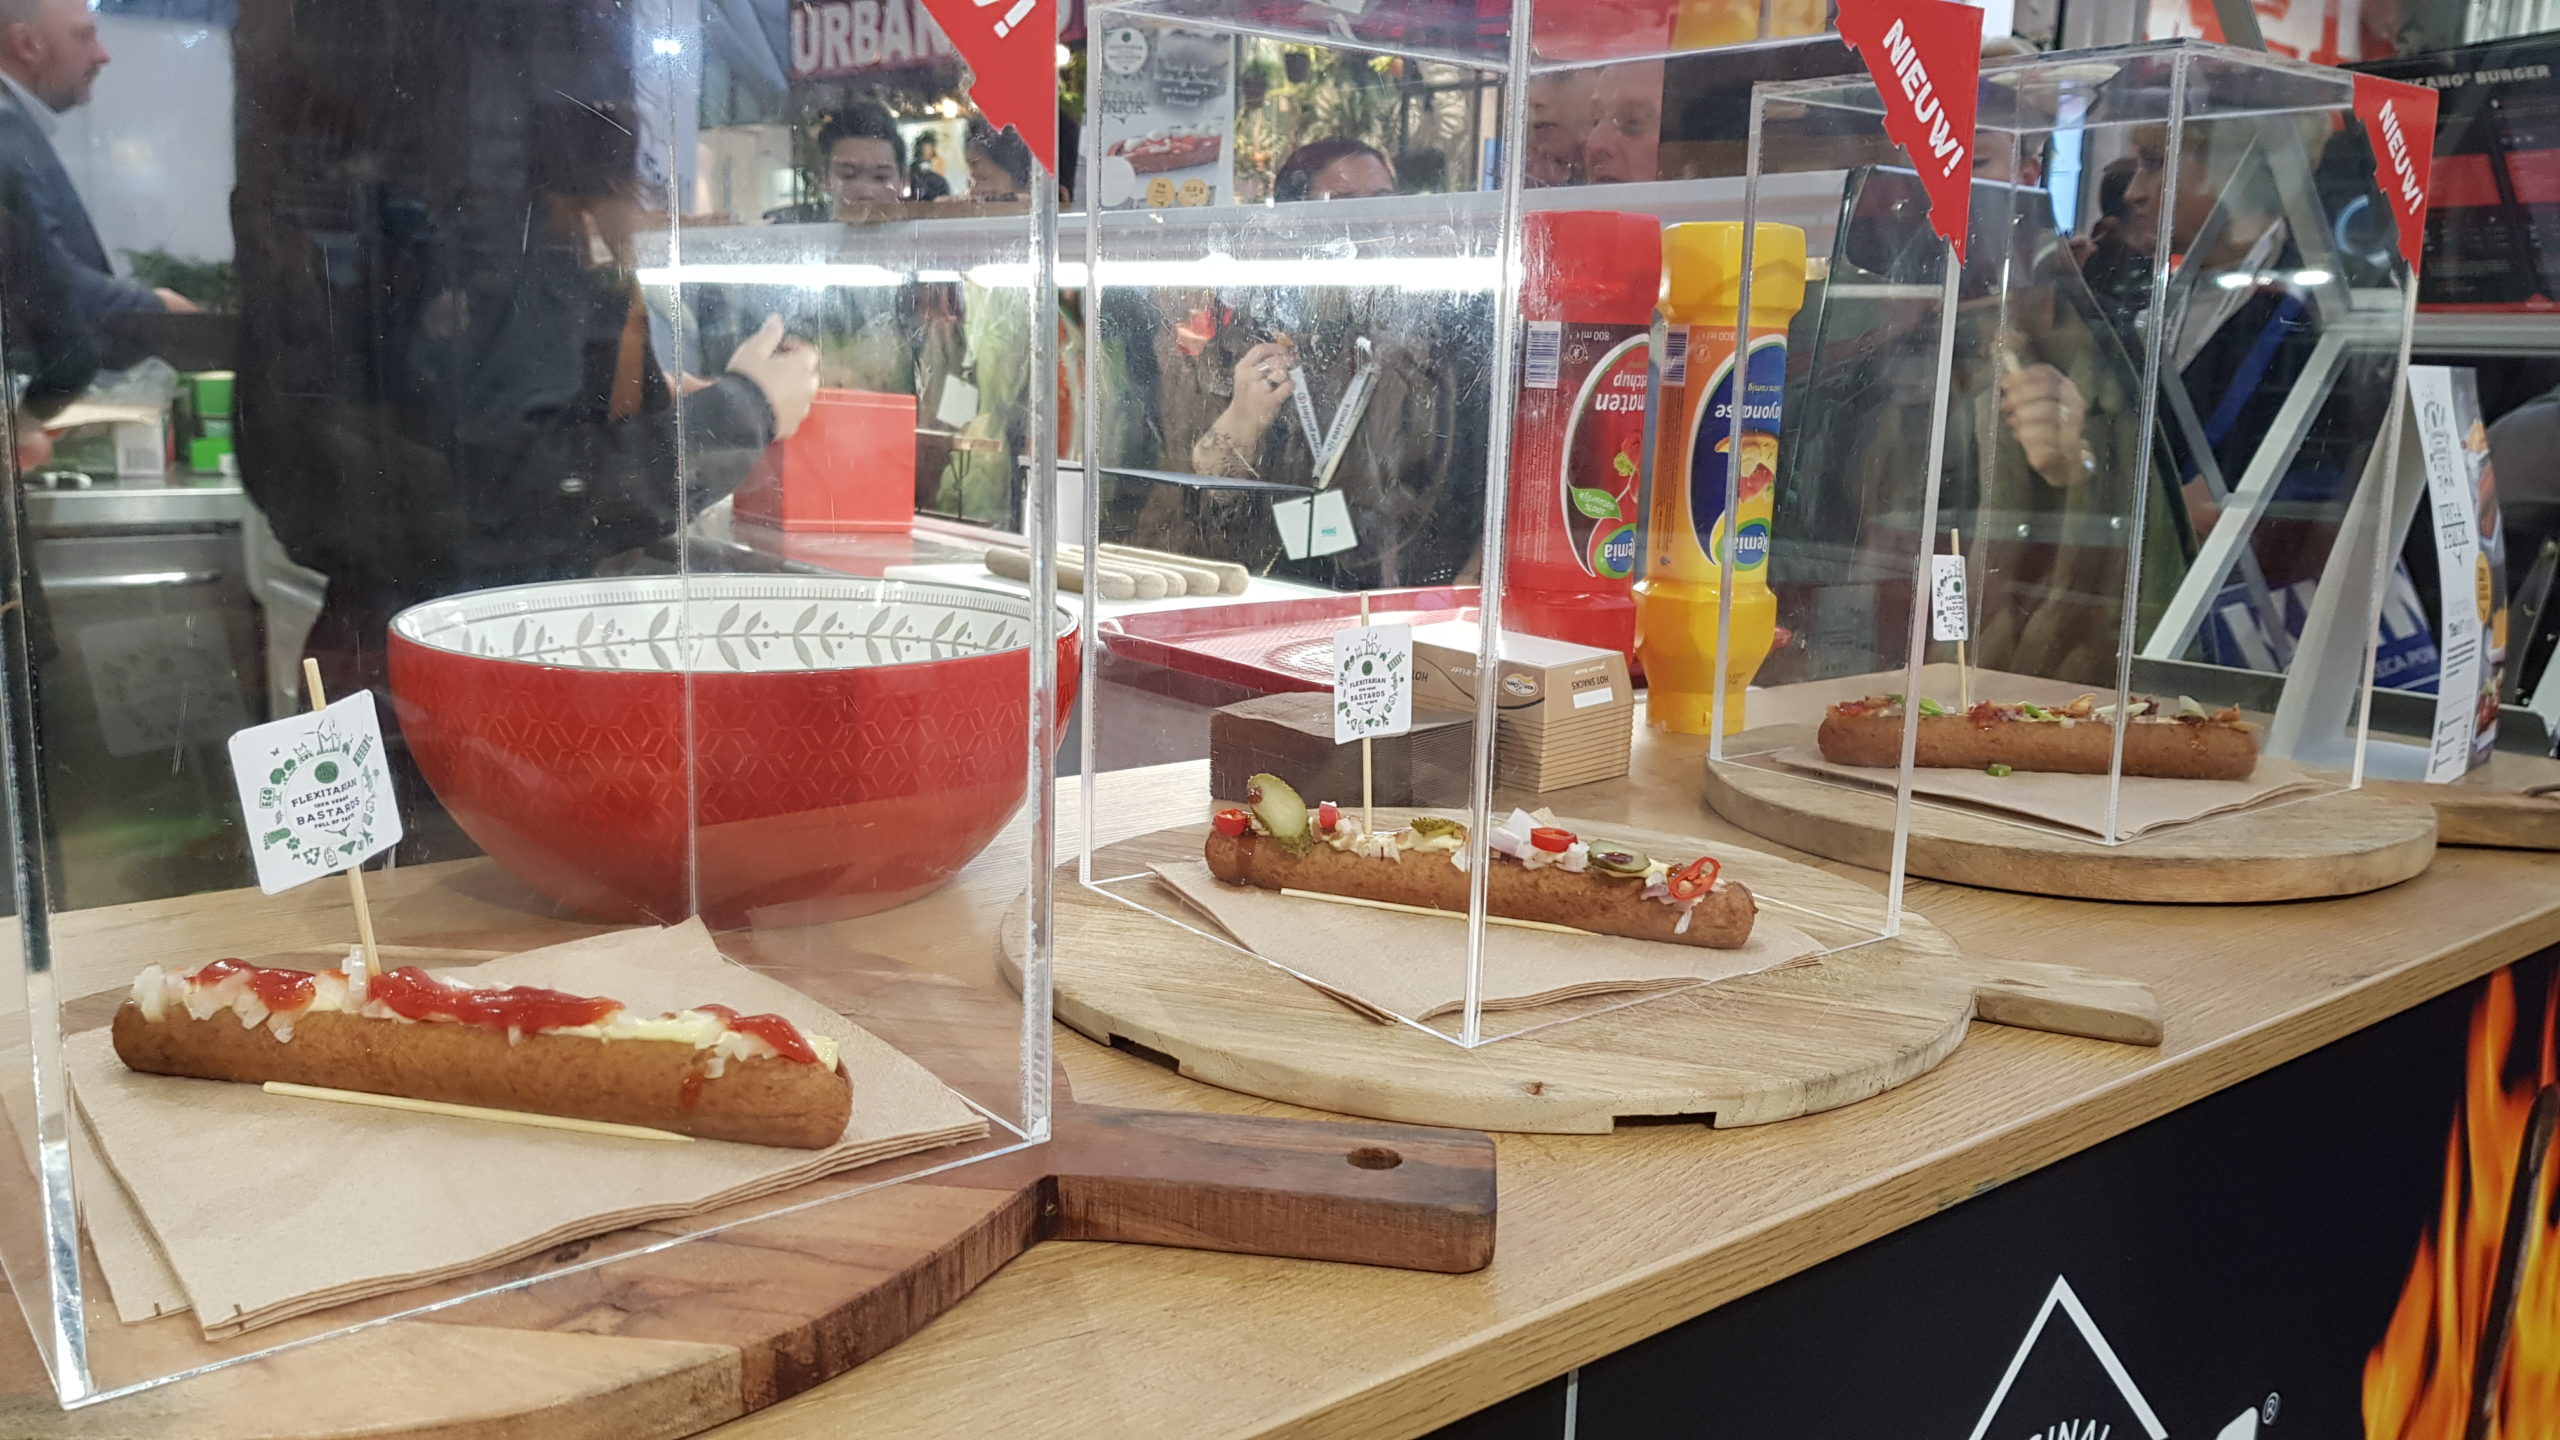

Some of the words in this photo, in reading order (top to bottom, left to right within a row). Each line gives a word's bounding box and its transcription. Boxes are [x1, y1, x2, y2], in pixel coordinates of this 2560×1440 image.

[2474, 64, 2551, 85] BURGER
[1882, 17, 1965, 178] NIEUW!
[2378, 99, 2424, 216] NIEUW!
[1593, 331, 1610, 341] 800
[1747, 383, 1769, 394] romig
[1595, 394, 1645, 414] maten
[1715, 401, 1782, 422] ayonase
[1584, 503, 1606, 515] 100%
[1604, 537, 1636, 561] emia
[1571, 676, 1596, 690] SNACKS
[1596, 675, 1609, 686] HOT
[1350, 691, 1385, 702] BASTARDS
[261, 789, 273, 807] ECO
[290, 777, 358, 808] FLEXITARIAN
[296, 796, 361, 826] BASTARDS
[314, 821, 330, 829] FULL
